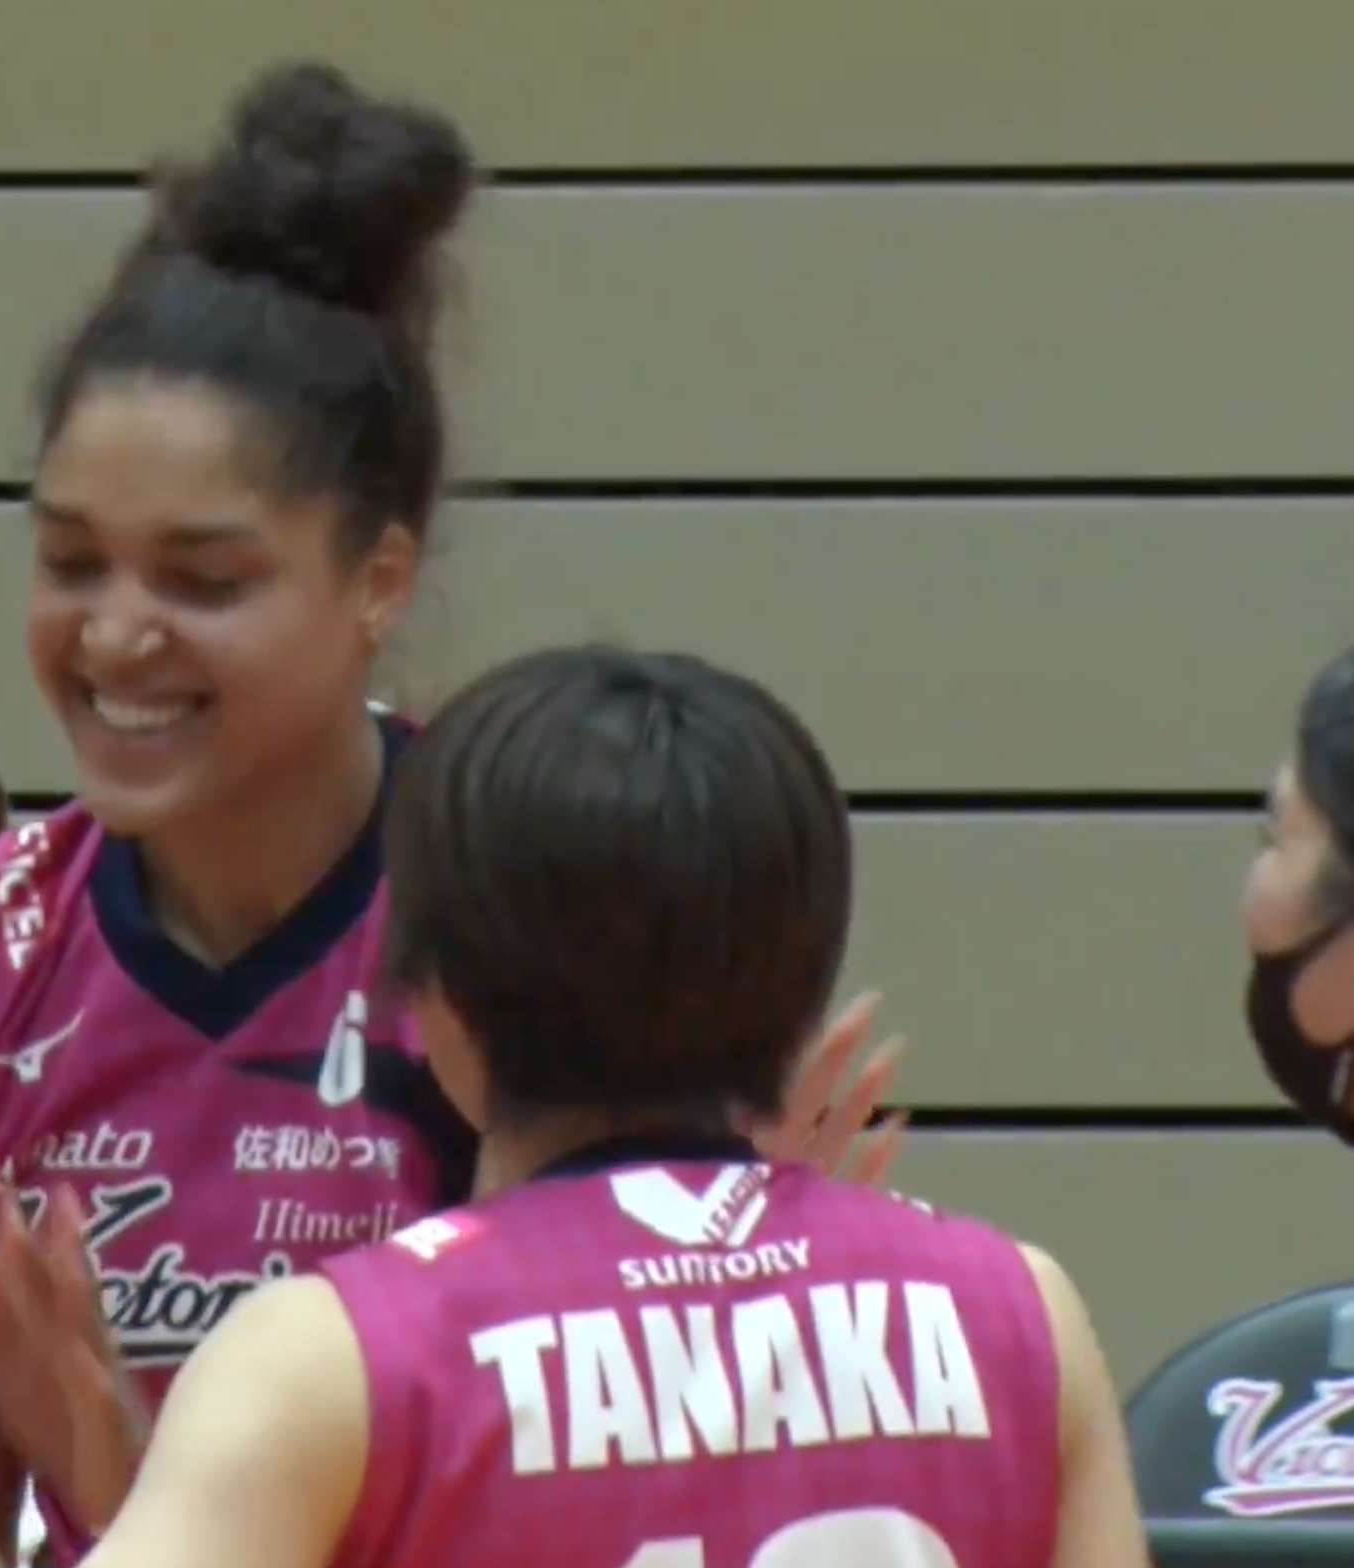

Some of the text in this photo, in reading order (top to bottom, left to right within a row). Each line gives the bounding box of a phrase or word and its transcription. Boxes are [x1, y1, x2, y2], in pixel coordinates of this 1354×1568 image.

[254, 1199, 399, 1244] Himeji
[617, 1236, 811, 1290] SUNTORY
[469, 1280, 991, 1475] TANAKA
